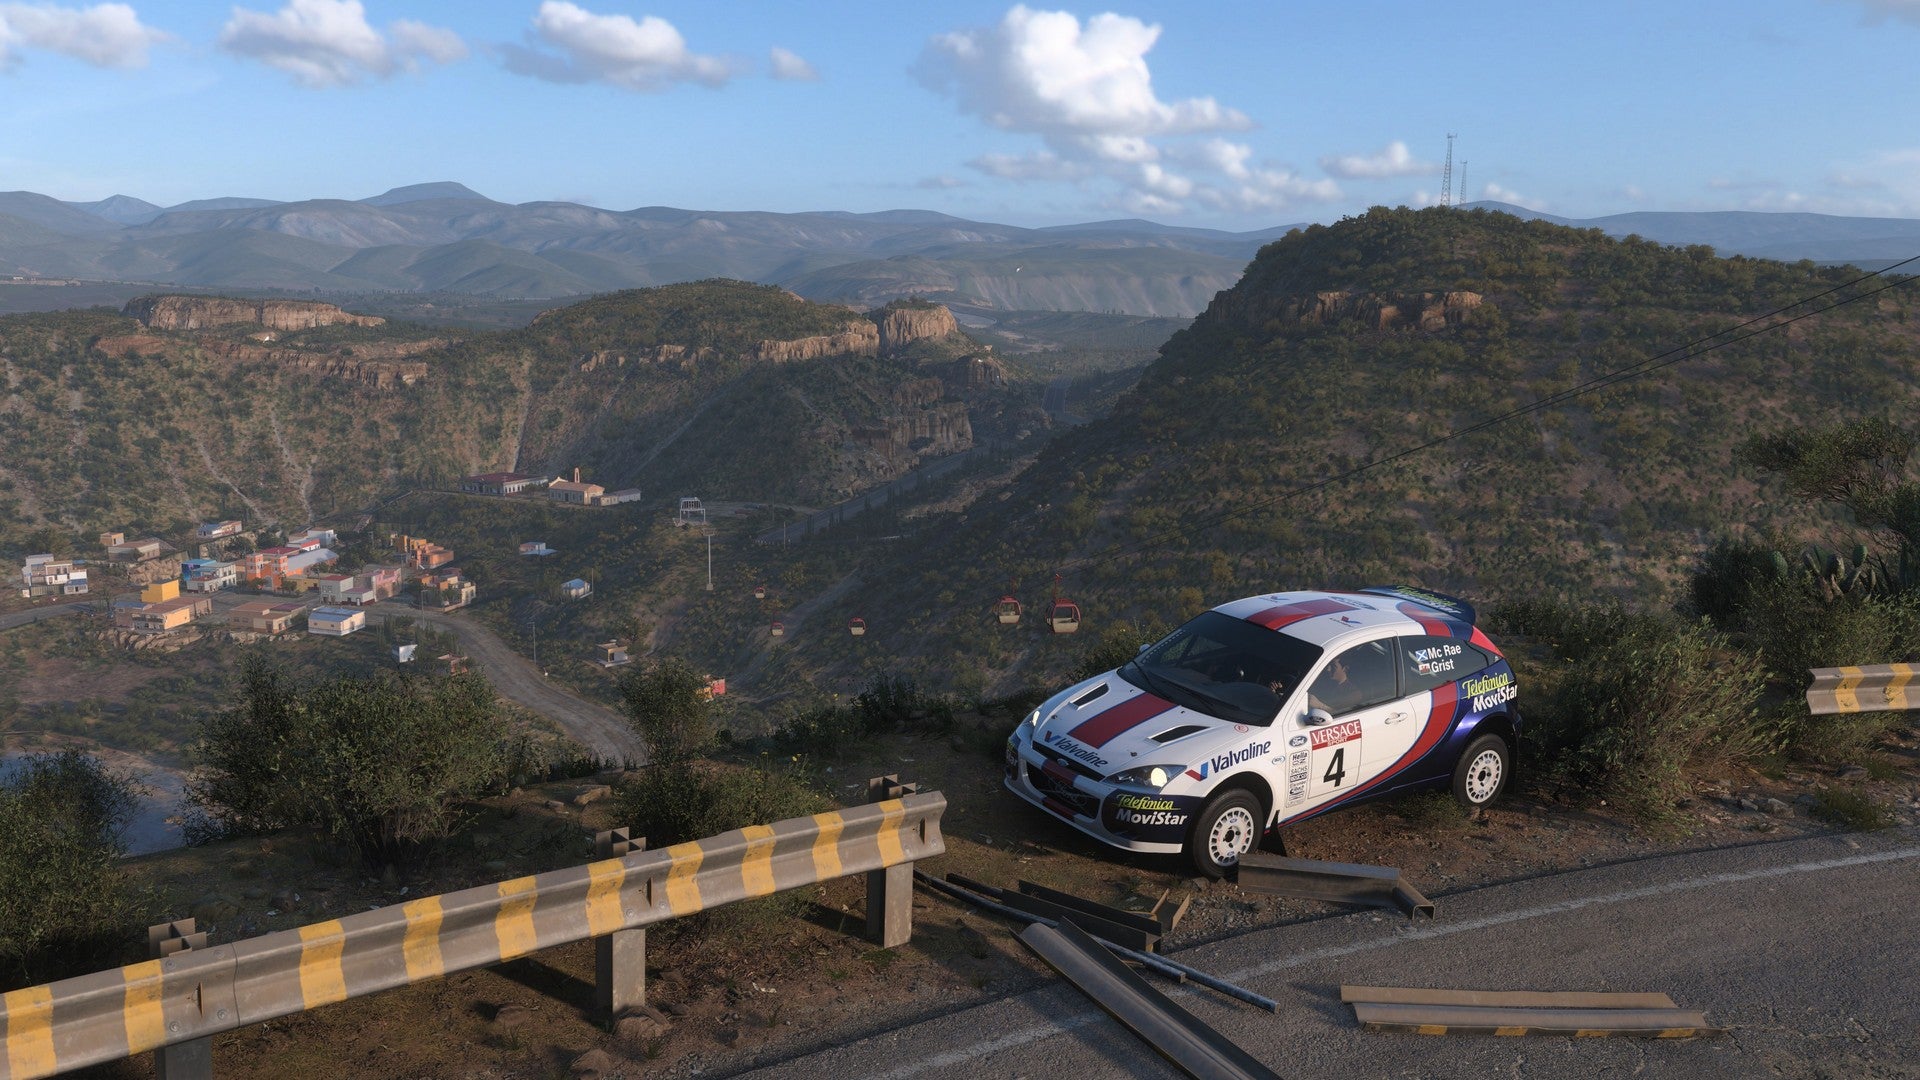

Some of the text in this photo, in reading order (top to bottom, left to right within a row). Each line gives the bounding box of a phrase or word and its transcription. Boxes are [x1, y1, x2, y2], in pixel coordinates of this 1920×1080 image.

[1427, 645, 1462, 660] Mc Rae
[1431, 660, 1455, 673] Grist
[1473, 685, 1518, 713] MoviStar
[1311, 721, 1362, 745] VERSACE
[1054, 738, 1108, 768] Valvoline
[1211, 741, 1271, 773] Valvoline
[1323, 748, 1346, 787] 4
[1116, 809, 1187, 825] MoviStar
